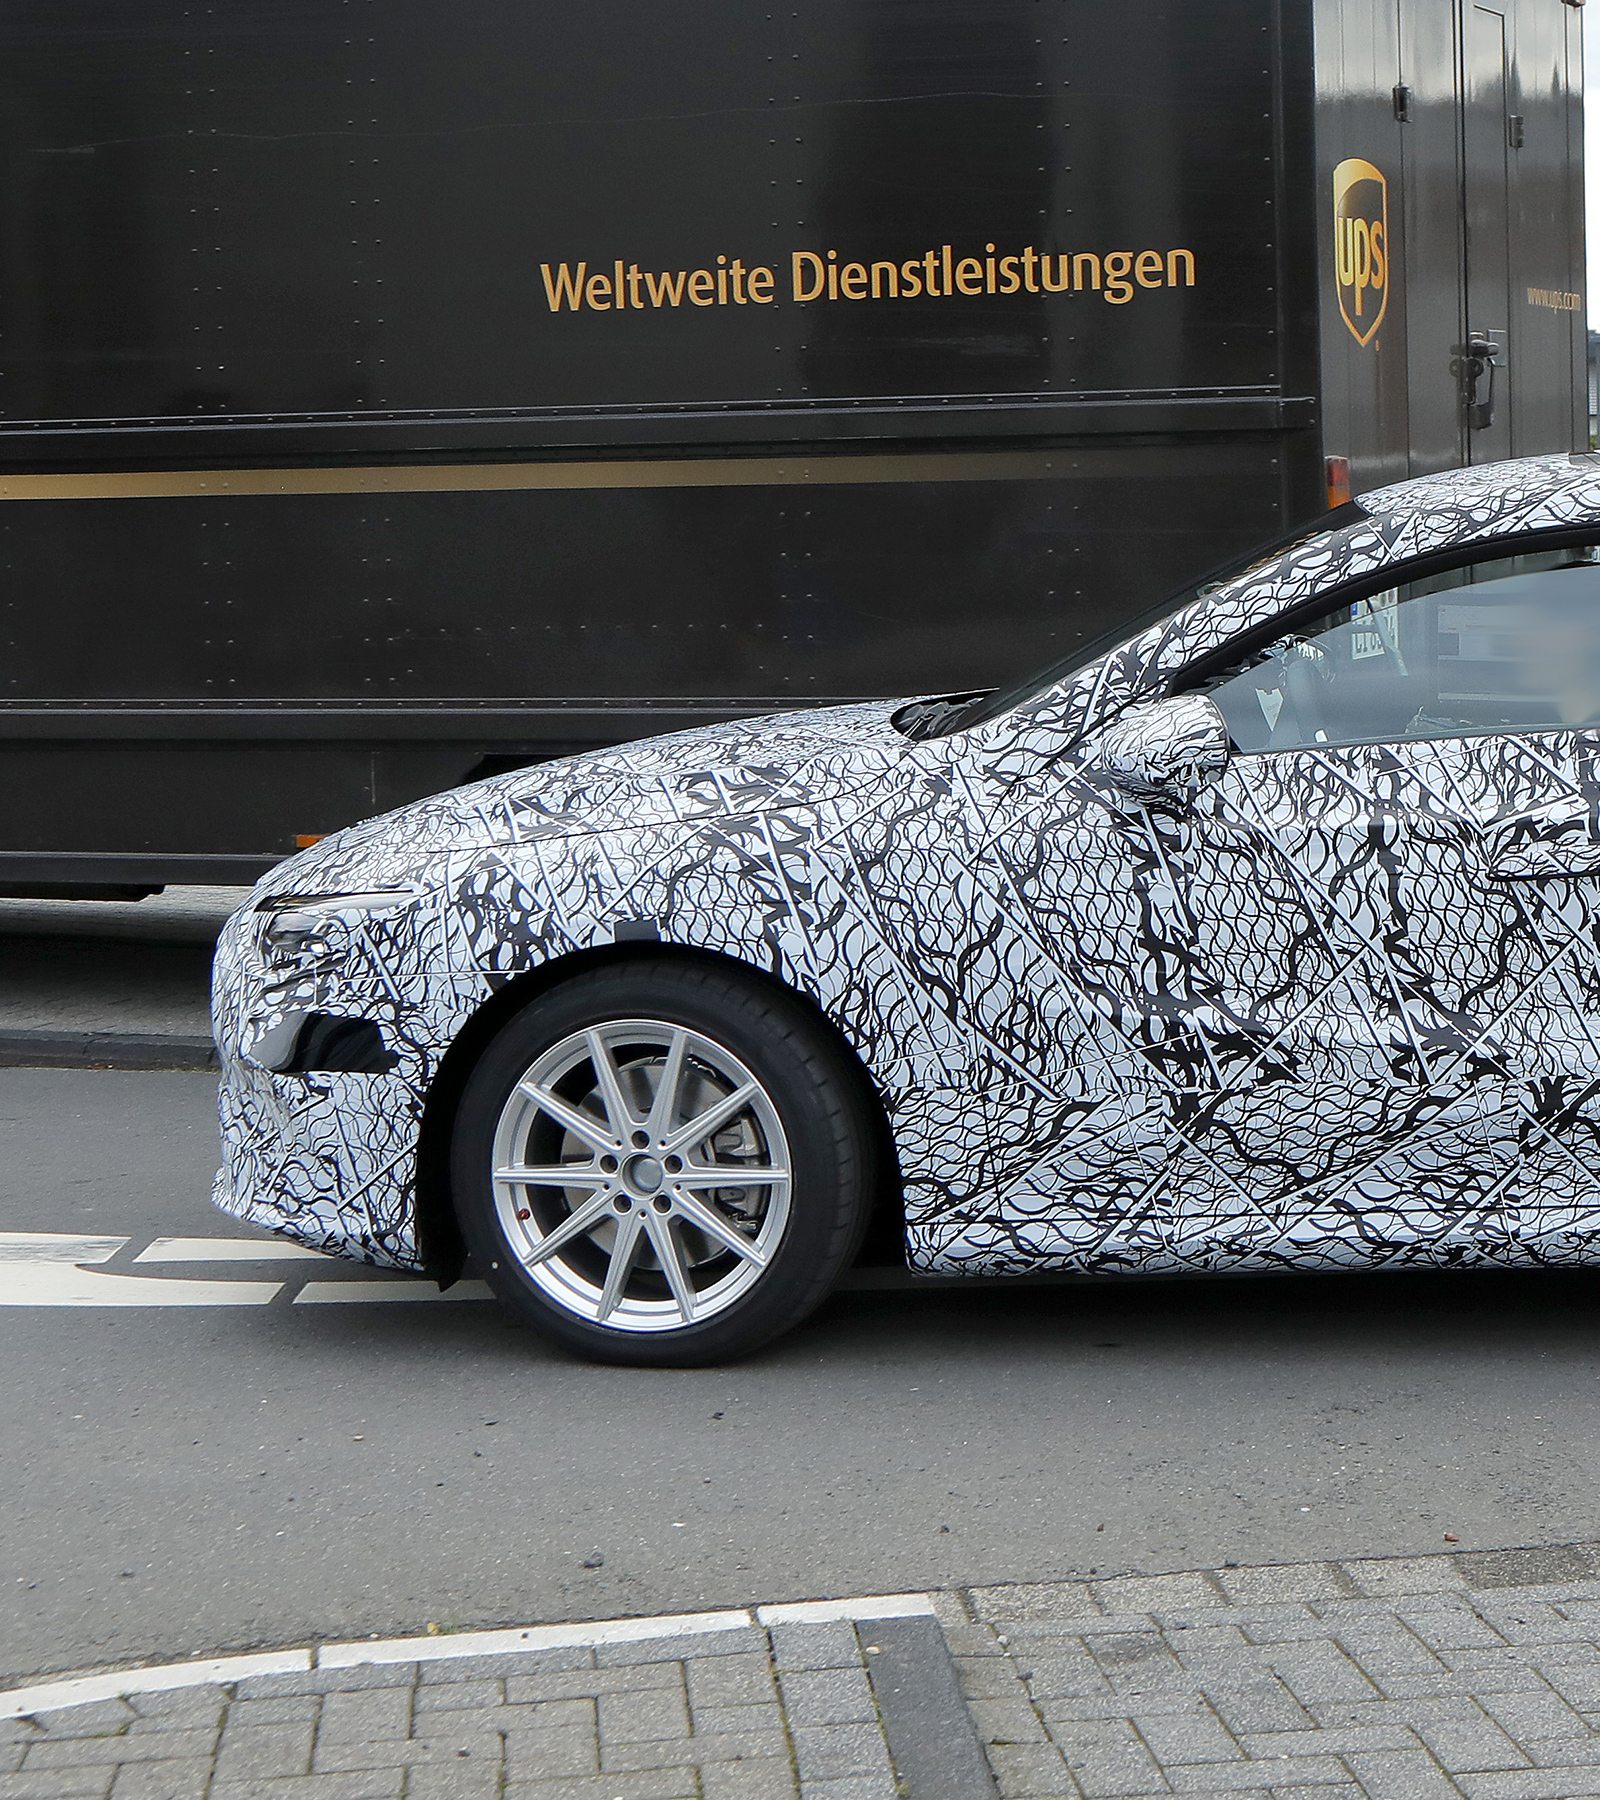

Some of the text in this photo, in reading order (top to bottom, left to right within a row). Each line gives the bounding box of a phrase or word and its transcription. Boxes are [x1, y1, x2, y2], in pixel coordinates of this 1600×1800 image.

[540, 242, 1196, 312] Weltweite Dienstleistungen
[1337, 216, 1385, 316] ups
[1526, 287, 1581, 315] www.ups.com
